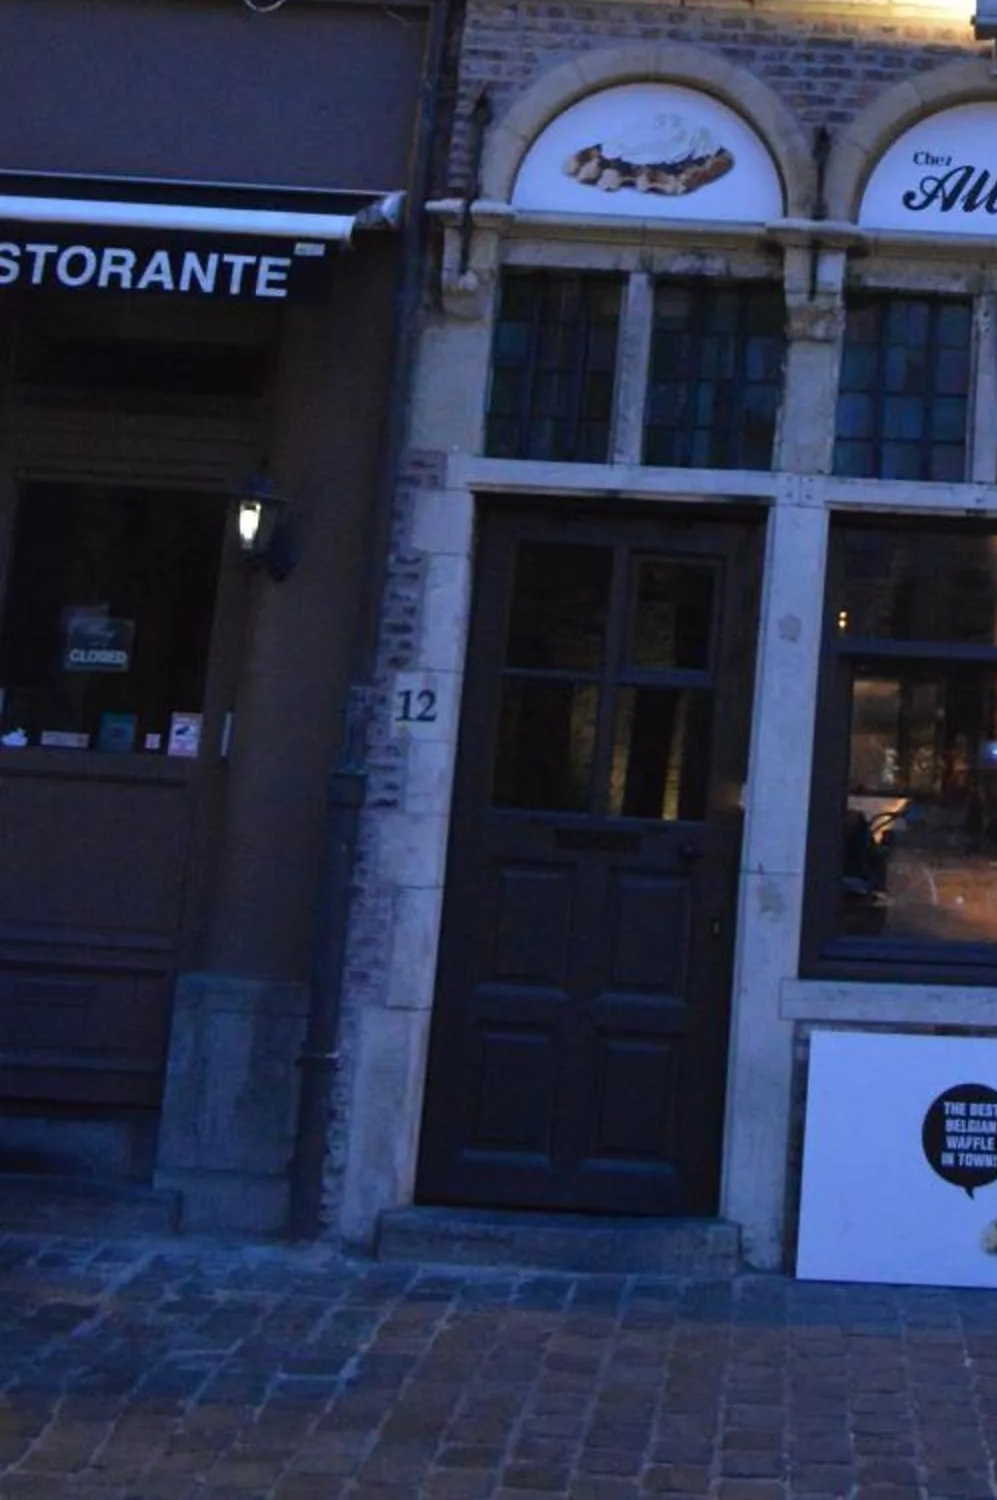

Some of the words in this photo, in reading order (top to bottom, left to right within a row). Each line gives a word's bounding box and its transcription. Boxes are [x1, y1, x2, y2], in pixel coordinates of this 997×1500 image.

[912, 151, 953, 167] Chez
[0, 242, 292, 298] STORANTE
[69, 649, 128, 664] CLOSED
[395, 689, 438, 722] 12
[943, 1101, 967, 1117] THE
[945, 1119, 997, 1134] BELGIAN
[945, 1135, 996, 1151] WAFFLE
